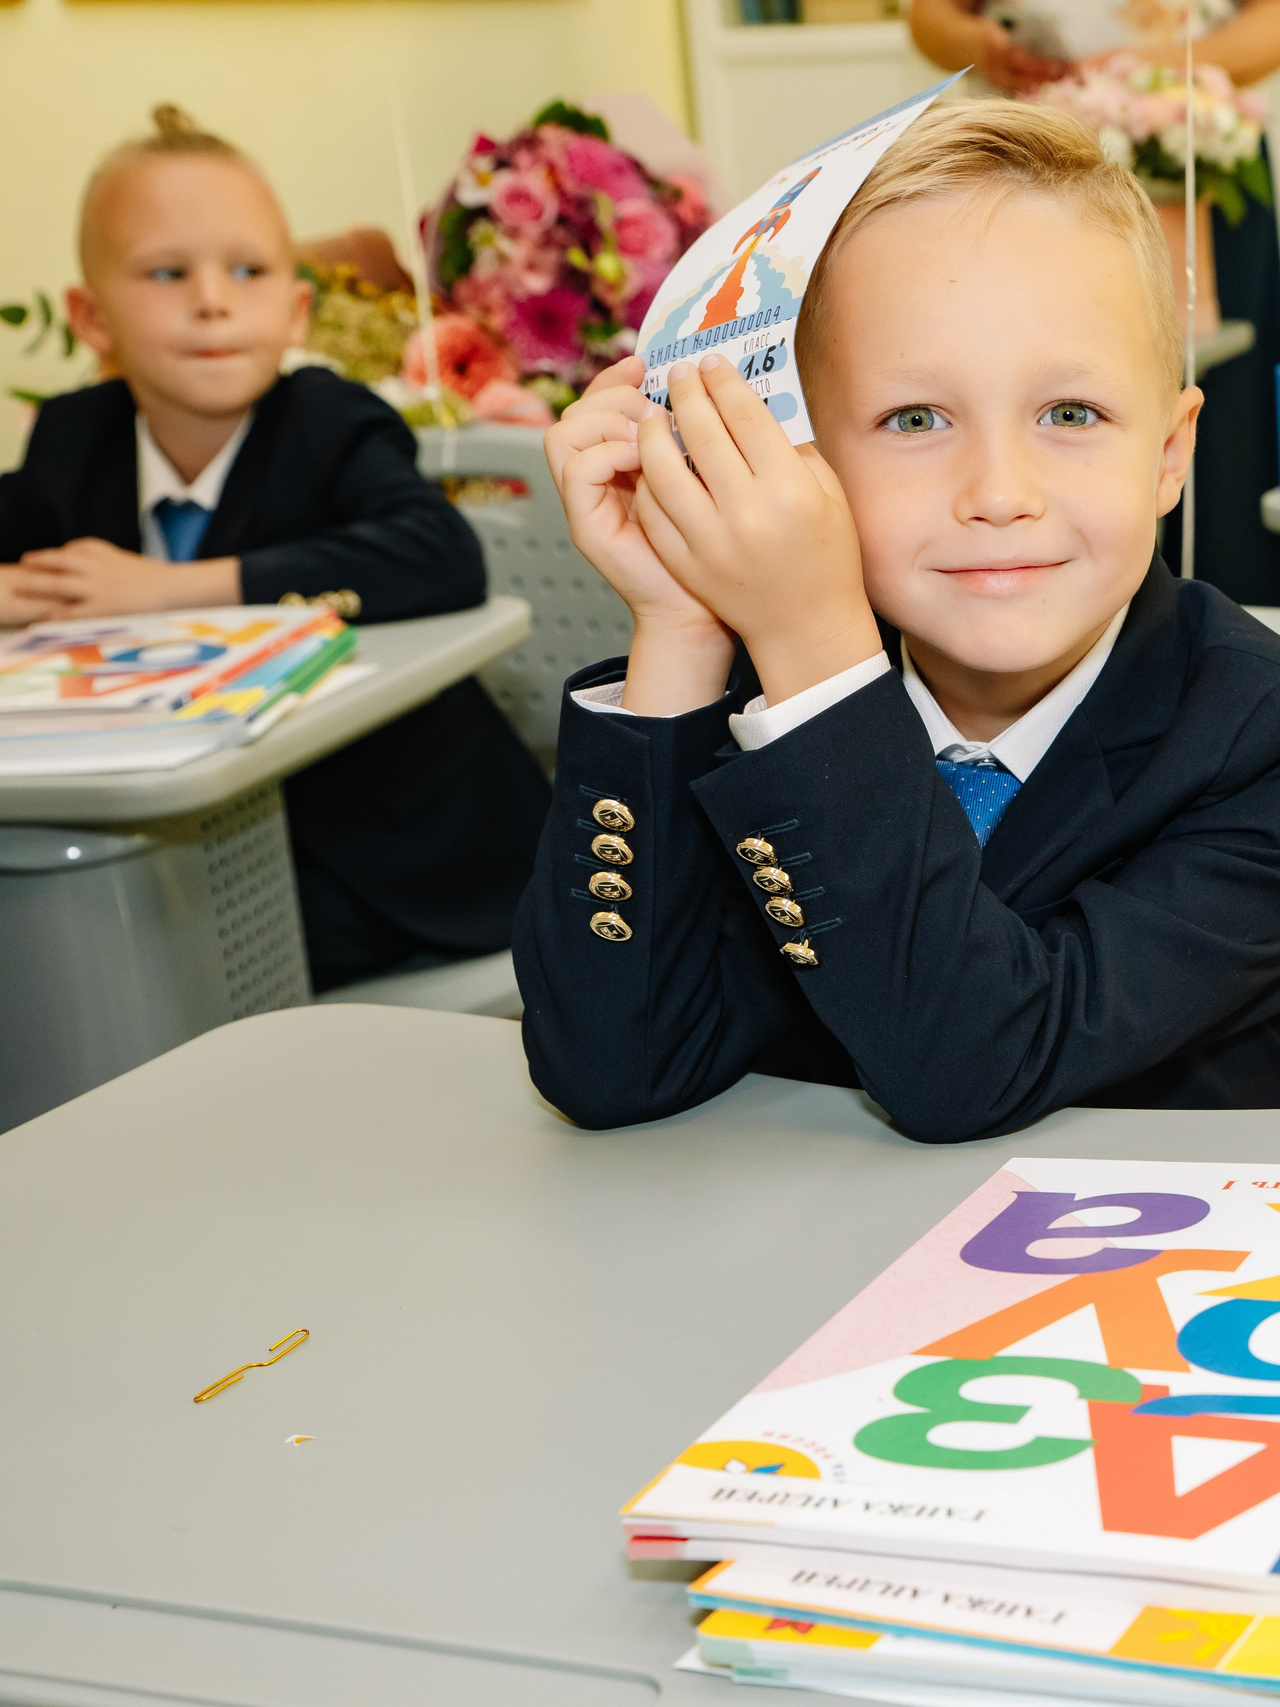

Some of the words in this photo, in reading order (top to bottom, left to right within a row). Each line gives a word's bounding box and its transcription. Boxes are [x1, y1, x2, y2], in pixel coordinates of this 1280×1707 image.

[649, 338, 687, 367] БИЛЕТ
[743, 332, 771, 354] КЛАСС
[644, 374, 660, 393] ИМЯ
[1220, 1178, 1238, 1191] 1
[707, 1485, 853, 1515] АНДРЕЙ
[862, 1498, 986, 1521] ГАНЖА
[788, 1567, 933, 1600] АНДРЕЙ
[941, 1590, 1067, 1624] ГАНЖА
